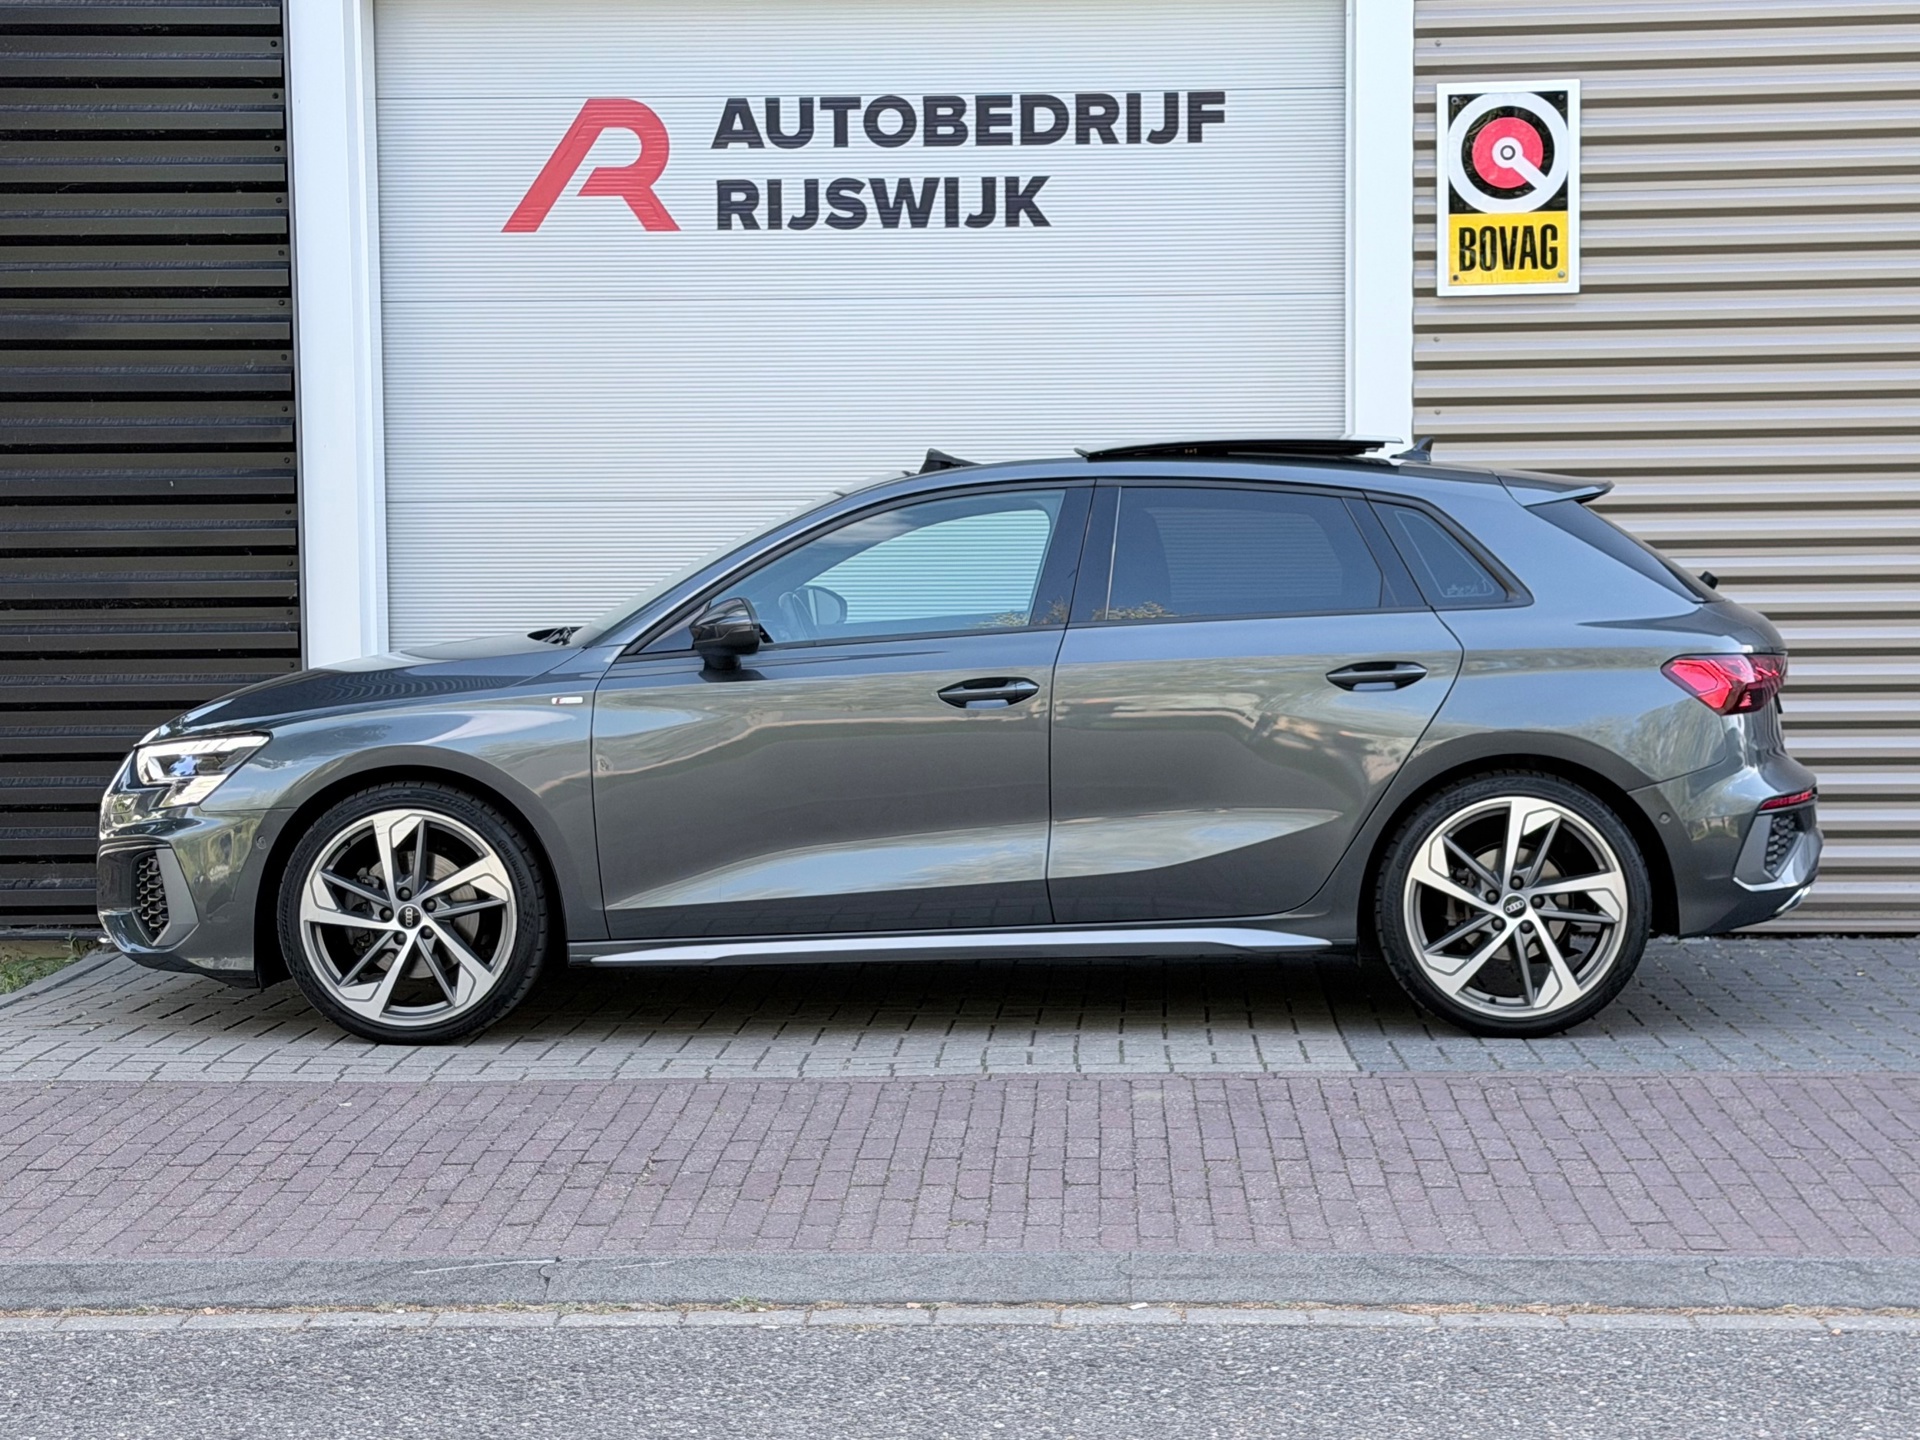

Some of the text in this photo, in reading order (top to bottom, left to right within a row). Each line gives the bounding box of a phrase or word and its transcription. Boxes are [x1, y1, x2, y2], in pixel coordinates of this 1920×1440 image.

[711, 91, 1225, 149] AUTOBEDRIJF
[716, 176, 1050, 231] RIJSWIJK
[1459, 224, 1558, 271] BOVAG
